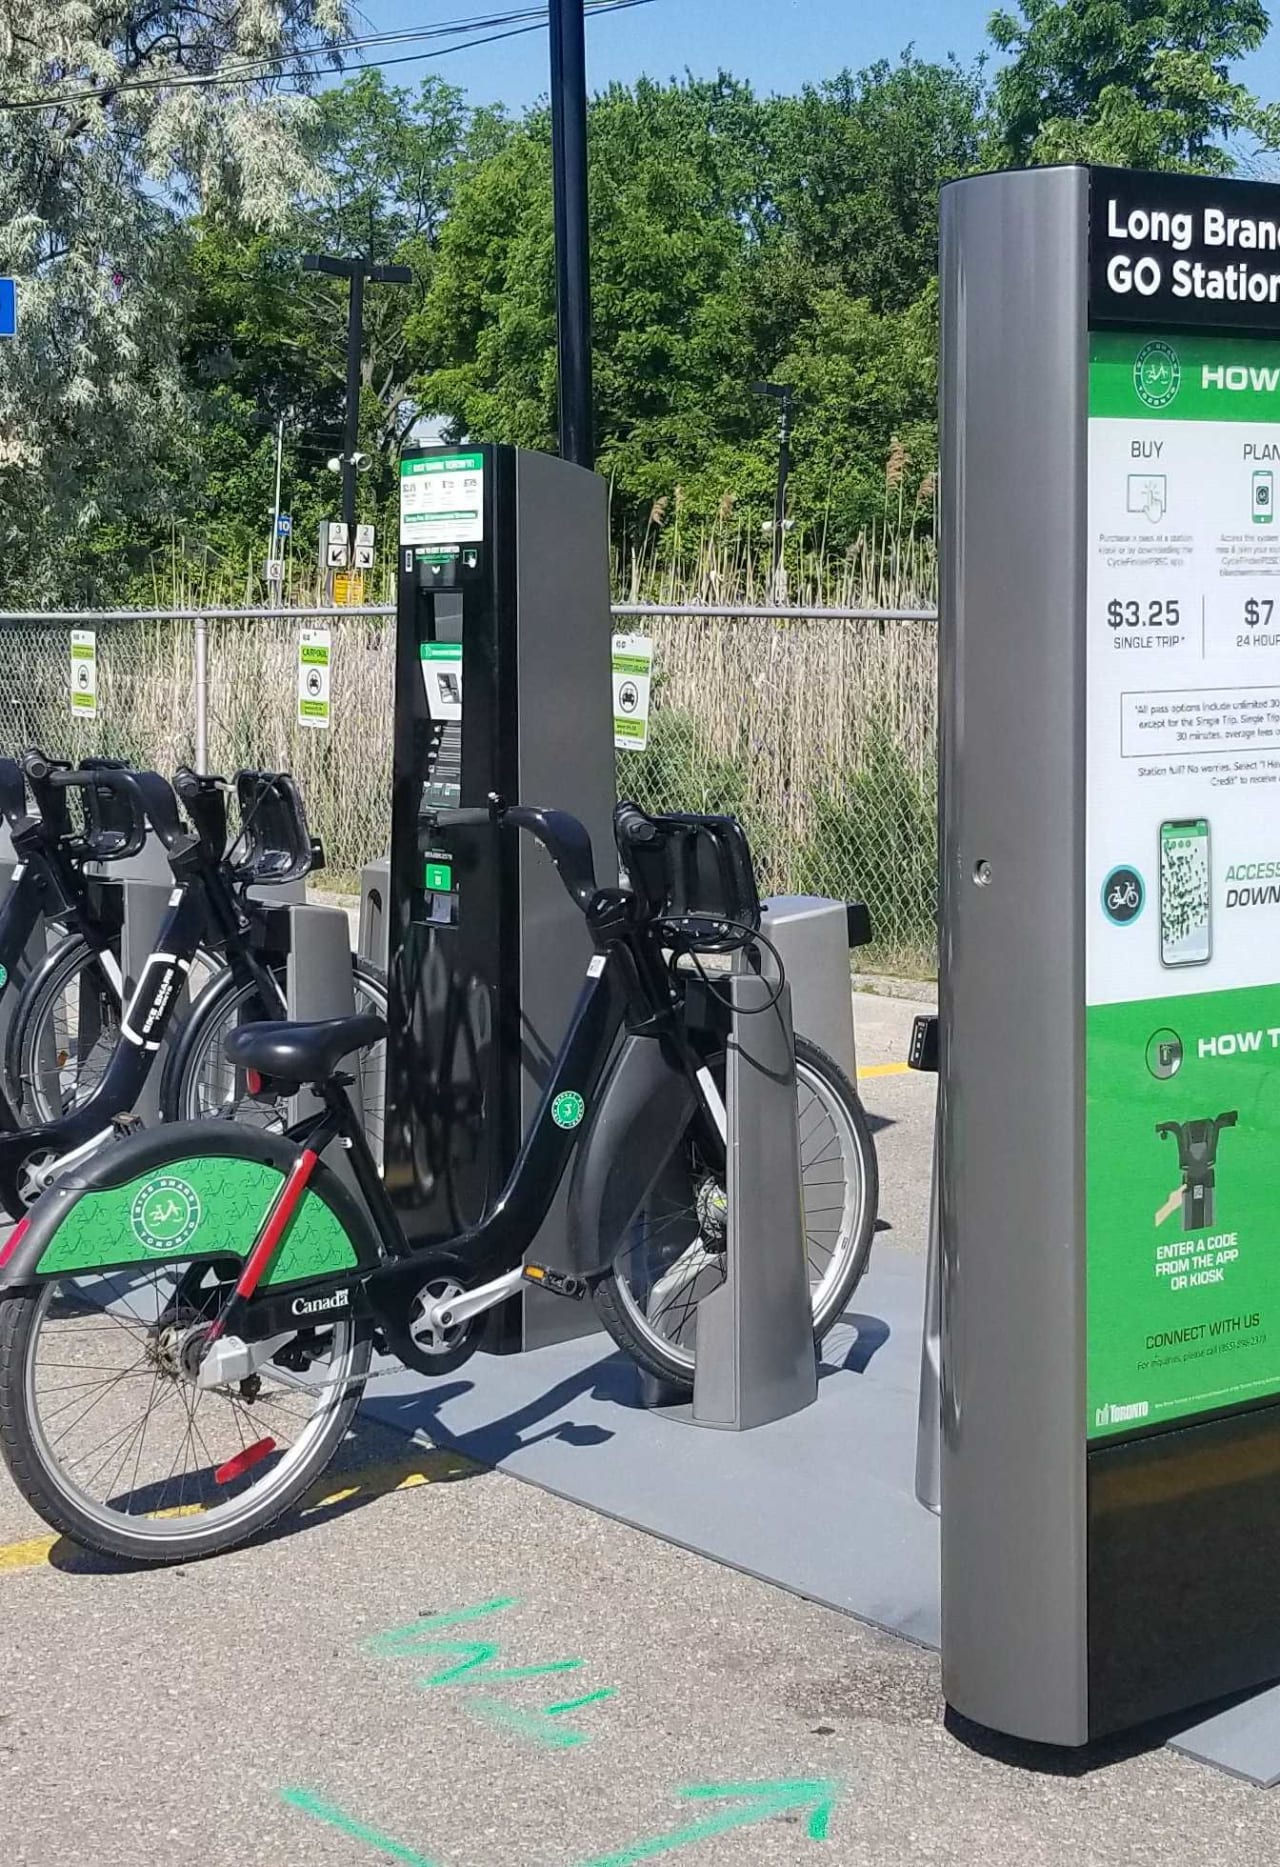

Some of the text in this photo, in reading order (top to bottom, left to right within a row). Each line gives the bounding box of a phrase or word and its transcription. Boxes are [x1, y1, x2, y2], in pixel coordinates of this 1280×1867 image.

[1108, 200, 1192, 251] Long
[1107, 256, 1160, 296] GO
[1131, 441, 1163, 458] BUY
[1107, 598, 1180, 631] $3.25
[1244, 597, 1274, 628] $7
[1113, 637, 1153, 649] SINGLE
[1236, 635, 1250, 647] 24
[1198, 1030, 1263, 1058] HOW
[1157, 1232, 1238, 1260] ENTER A CODE
[1155, 1249, 1238, 1278] FROM THE APP
[1170, 1268, 1224, 1290] OR KIOSK
[291, 1289, 349, 1316] Canada
[1145, 1312, 1260, 1350] CONNECT WITH US
[1110, 1401, 1149, 1424] TORONTO
